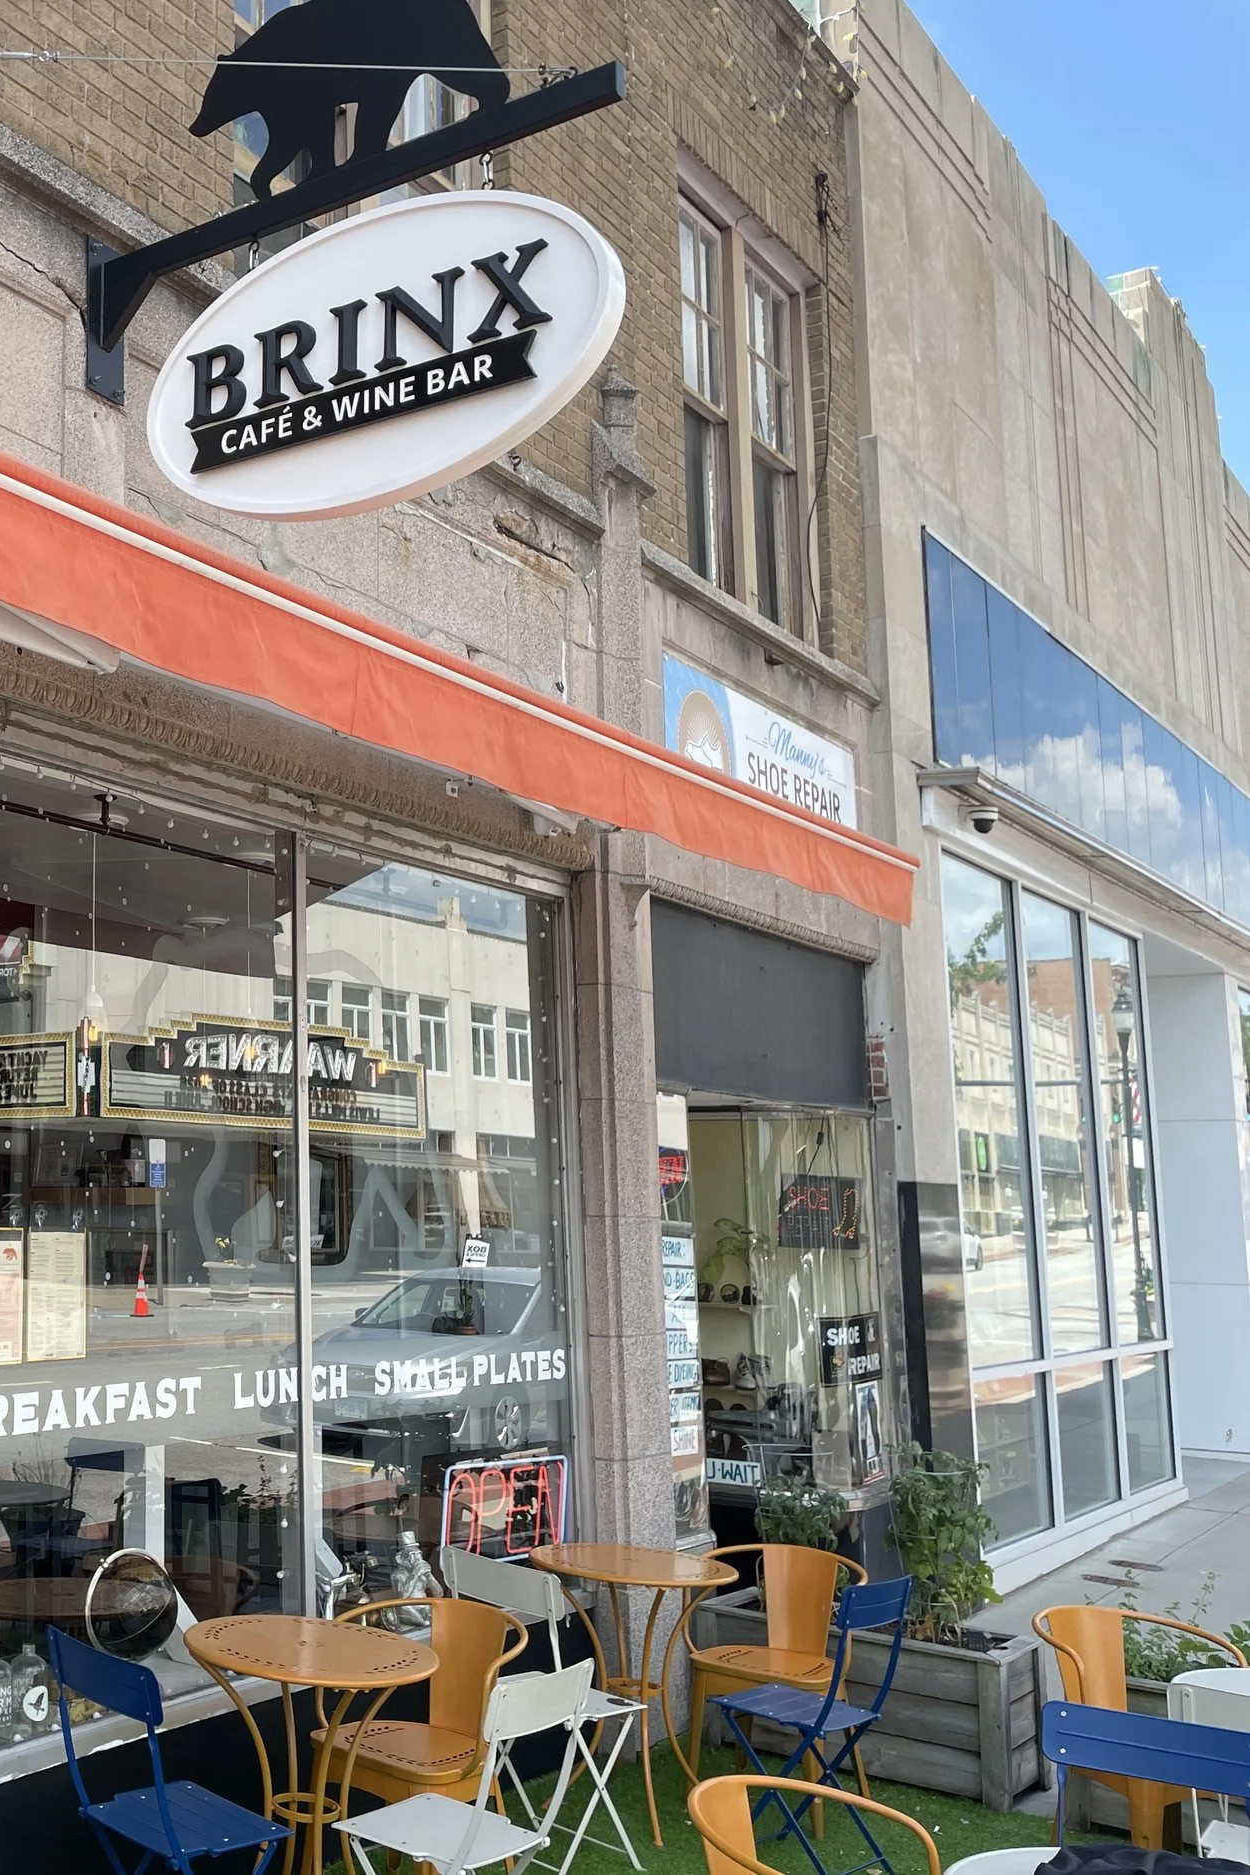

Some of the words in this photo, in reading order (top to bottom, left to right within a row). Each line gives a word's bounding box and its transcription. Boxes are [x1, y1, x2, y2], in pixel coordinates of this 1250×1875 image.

[185, 238, 553, 429] BRINX
[221, 406, 293, 454] CAFÉ
[302, 406, 323, 432] &
[332, 376, 416, 423] WINE
[426, 354, 494, 396] BAR
[768, 721, 827, 779] Manny's
[747, 752, 789, 800] SHOE
[793, 774, 842, 825] REPAIR
[788, 1186, 830, 1211] SHOE
[826, 1325, 861, 1346] SHOE
[847, 1353, 881, 1376] REPAIR
[233, 1363, 349, 1409] LUNCH
[374, 1355, 468, 1397] SMALL
[472, 1349, 566, 1388] PLATES
[672, 1429, 696, 1452] SHINE
[446, 1461, 564, 1556] OPEN
